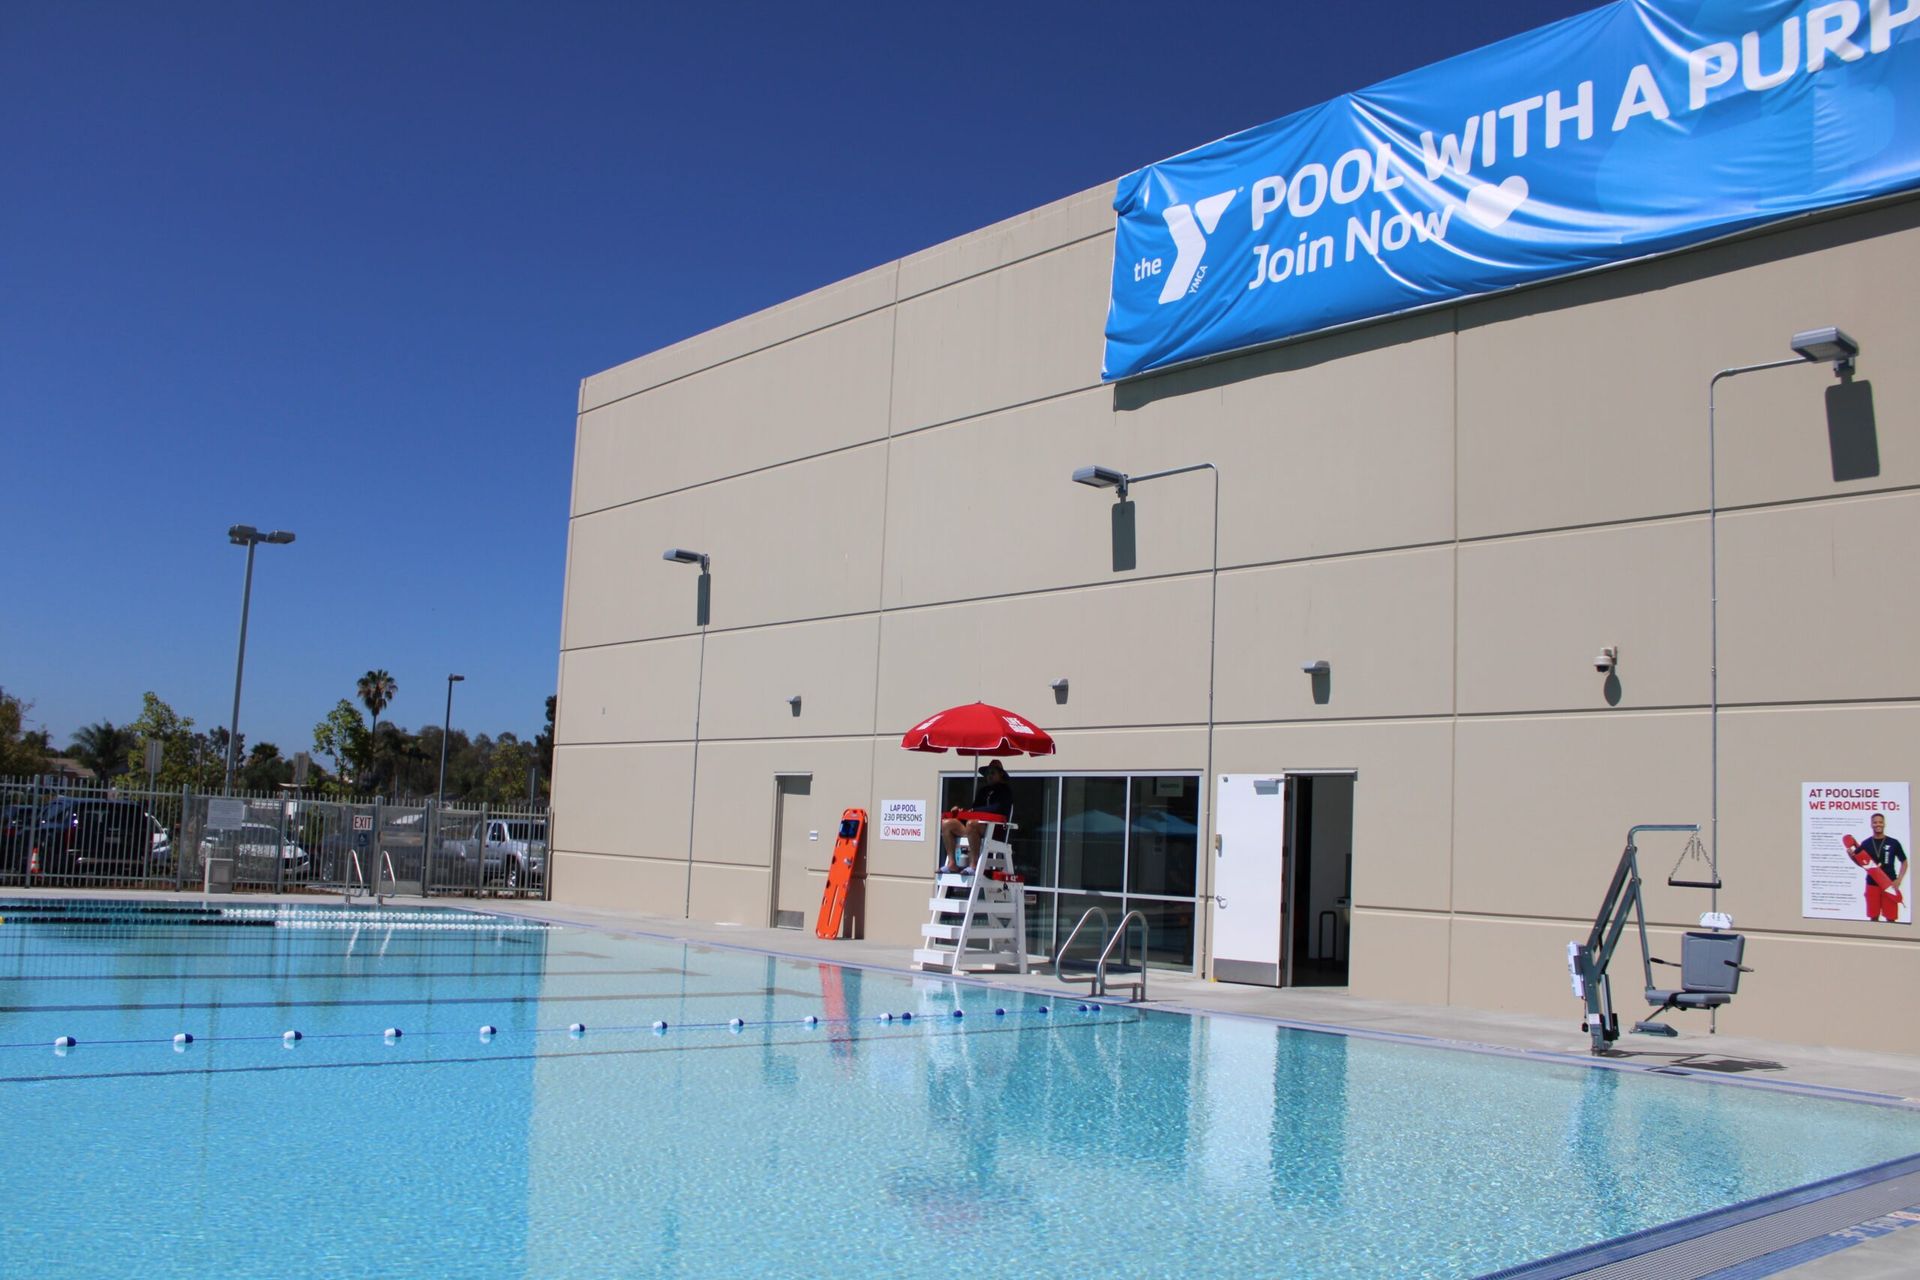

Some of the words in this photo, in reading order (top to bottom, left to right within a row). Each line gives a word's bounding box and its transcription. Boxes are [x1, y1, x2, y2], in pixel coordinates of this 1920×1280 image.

[1251, 143, 1404, 231] POOL
[1420, 80, 1593, 181] WITH
[1612, 64, 1670, 131] A
[1249, 232, 1334, 290] Join
[1345, 204, 1456, 262] Now
[1134, 257, 1162, 282] the
[1188, 265, 1208, 294] YMCA
[1809, 788, 1823, 798] AT
[1825, 788, 1880, 798] POOLSIDE
[890, 804, 901, 812] LAP
[901, 804, 917, 812] POOL
[1809, 800, 1825, 810] WE
[1828, 801, 1878, 811] PROMISE
[1881, 801, 1900, 811] TO:
[354, 816, 372, 828] EXIT
[884, 813, 895, 821] 230
[896, 813, 923, 822] PERSONS
[892, 828, 900, 836] NO
[901, 828, 921, 836] DIVING
